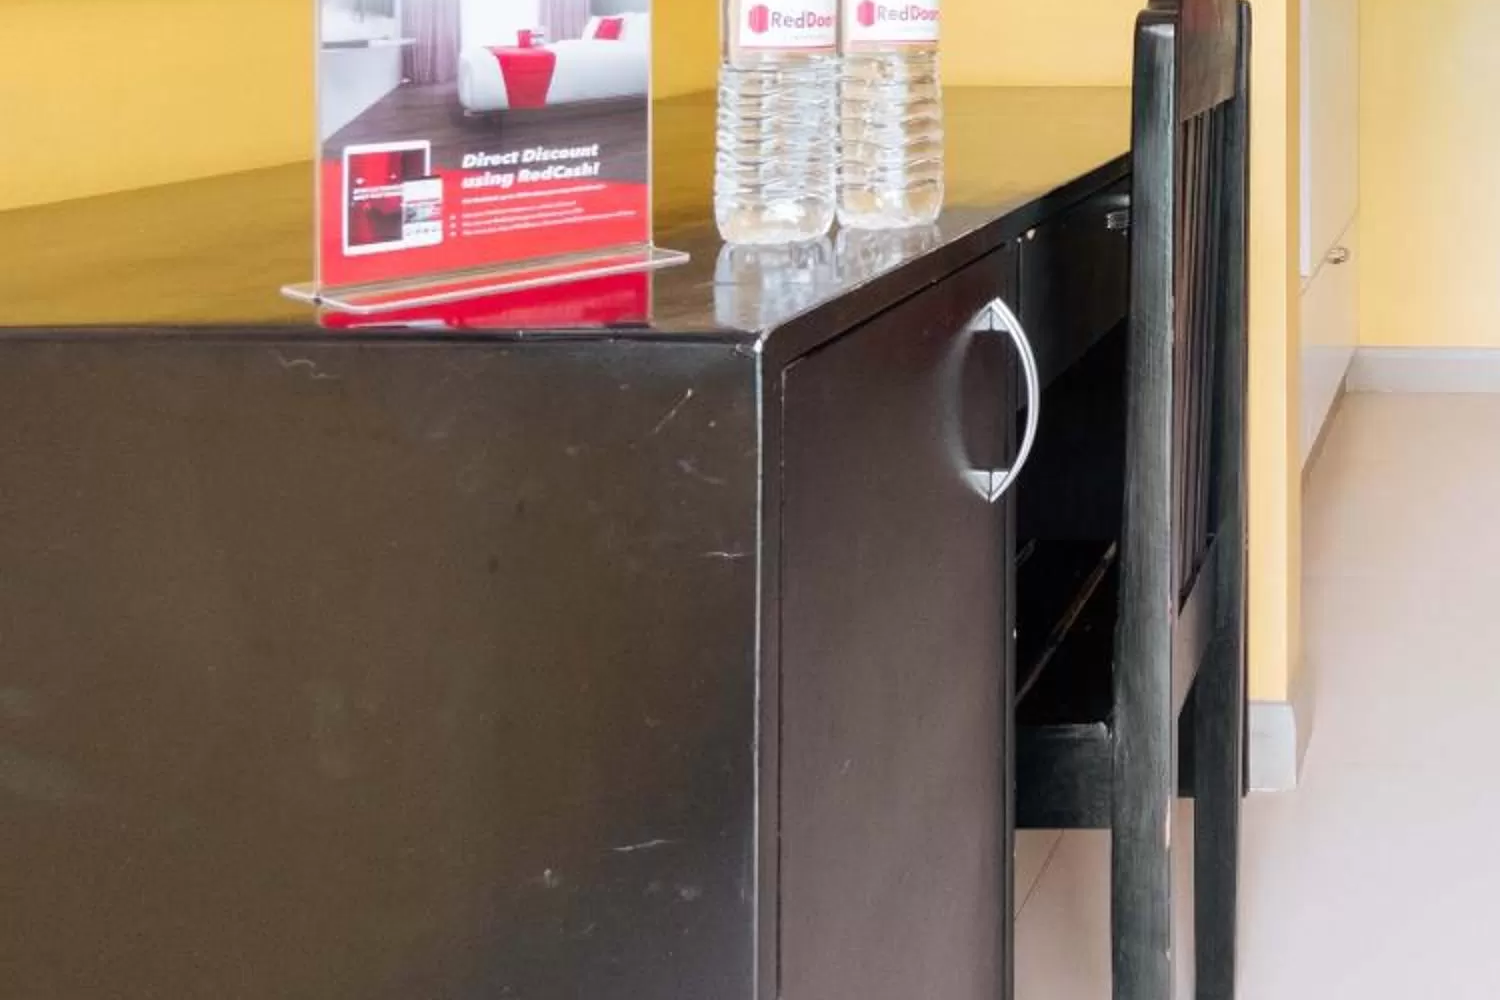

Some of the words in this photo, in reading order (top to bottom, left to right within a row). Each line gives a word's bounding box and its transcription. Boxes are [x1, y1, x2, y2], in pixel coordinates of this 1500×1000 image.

[462, 151, 518, 168] Direct
[522, 145, 599, 163] Discount
[461, 172, 514, 189] using
[518, 162, 600, 183] RedCash!
